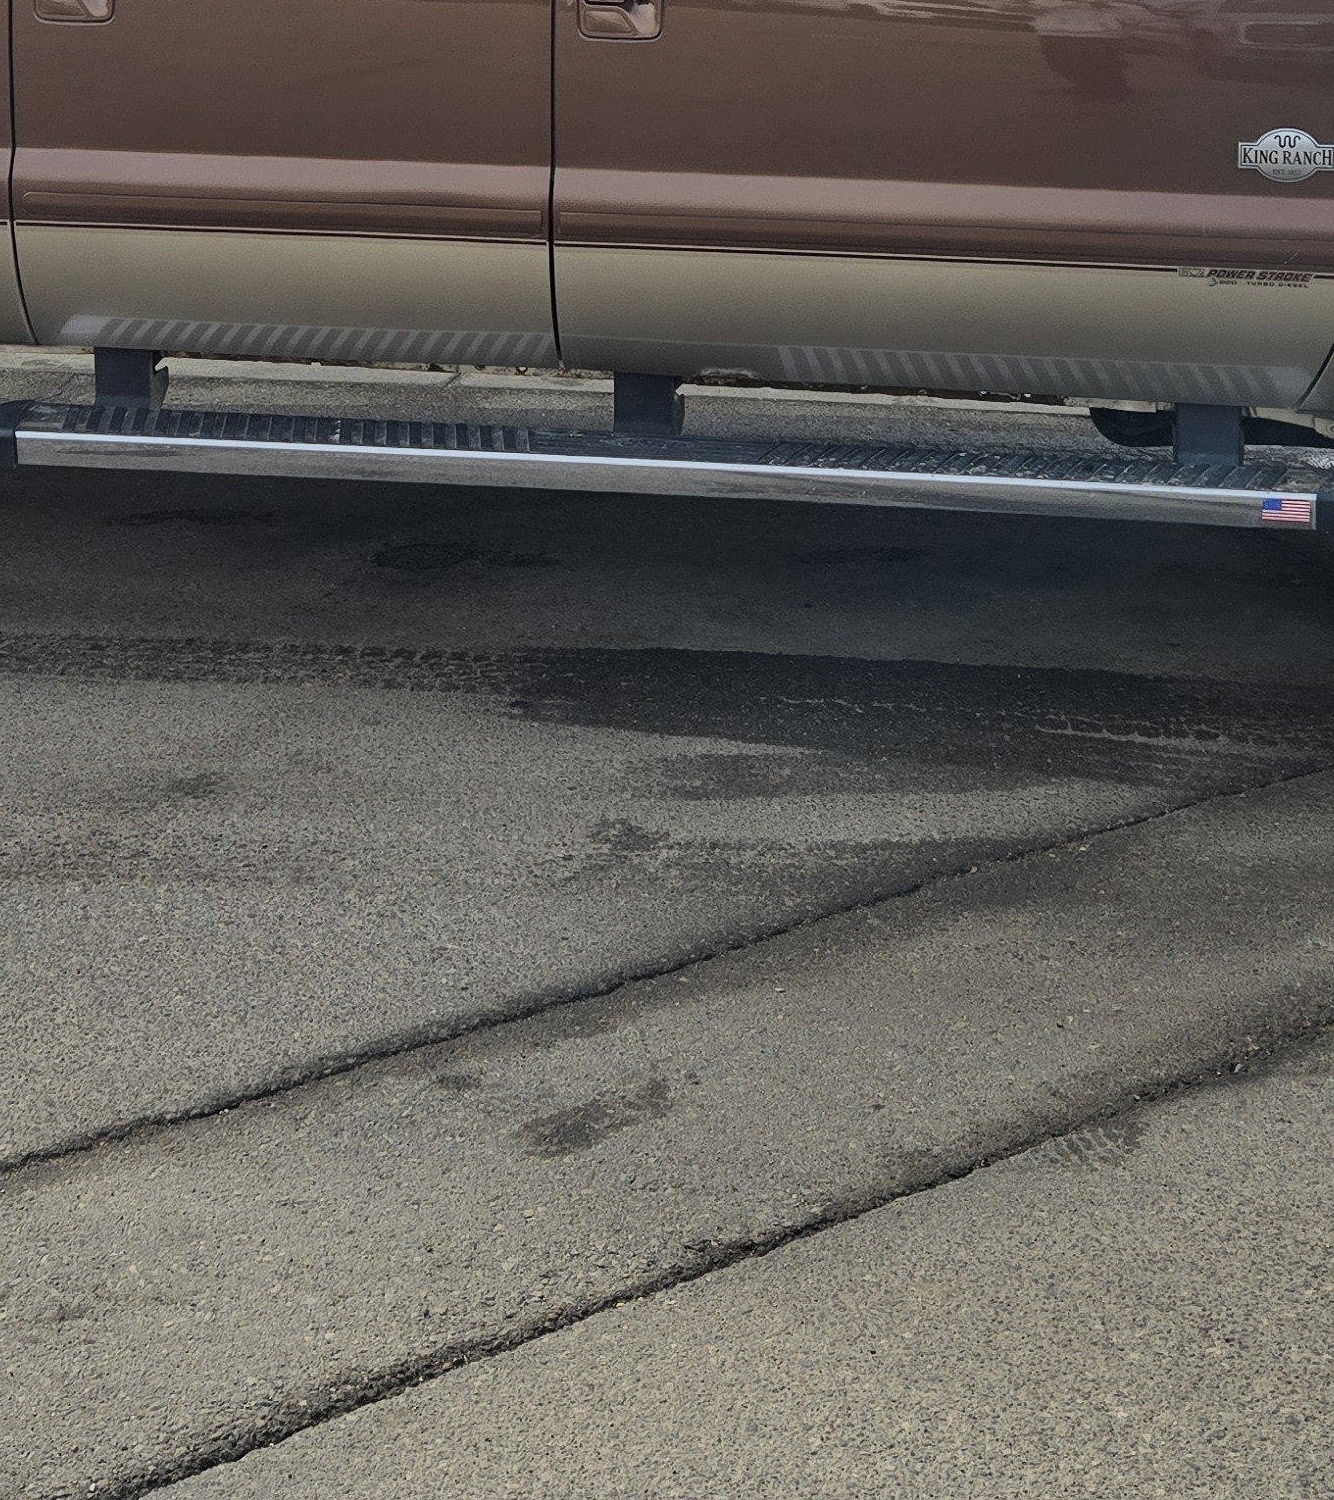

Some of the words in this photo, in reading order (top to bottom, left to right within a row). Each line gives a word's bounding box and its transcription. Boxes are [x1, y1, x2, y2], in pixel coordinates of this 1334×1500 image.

[1242, 148, 1278, 164] KING
[1282, 150, 1332, 165] RANCH
[1207, 269, 1257, 280] POWER
[1256, 271, 1314, 282] STROKE
